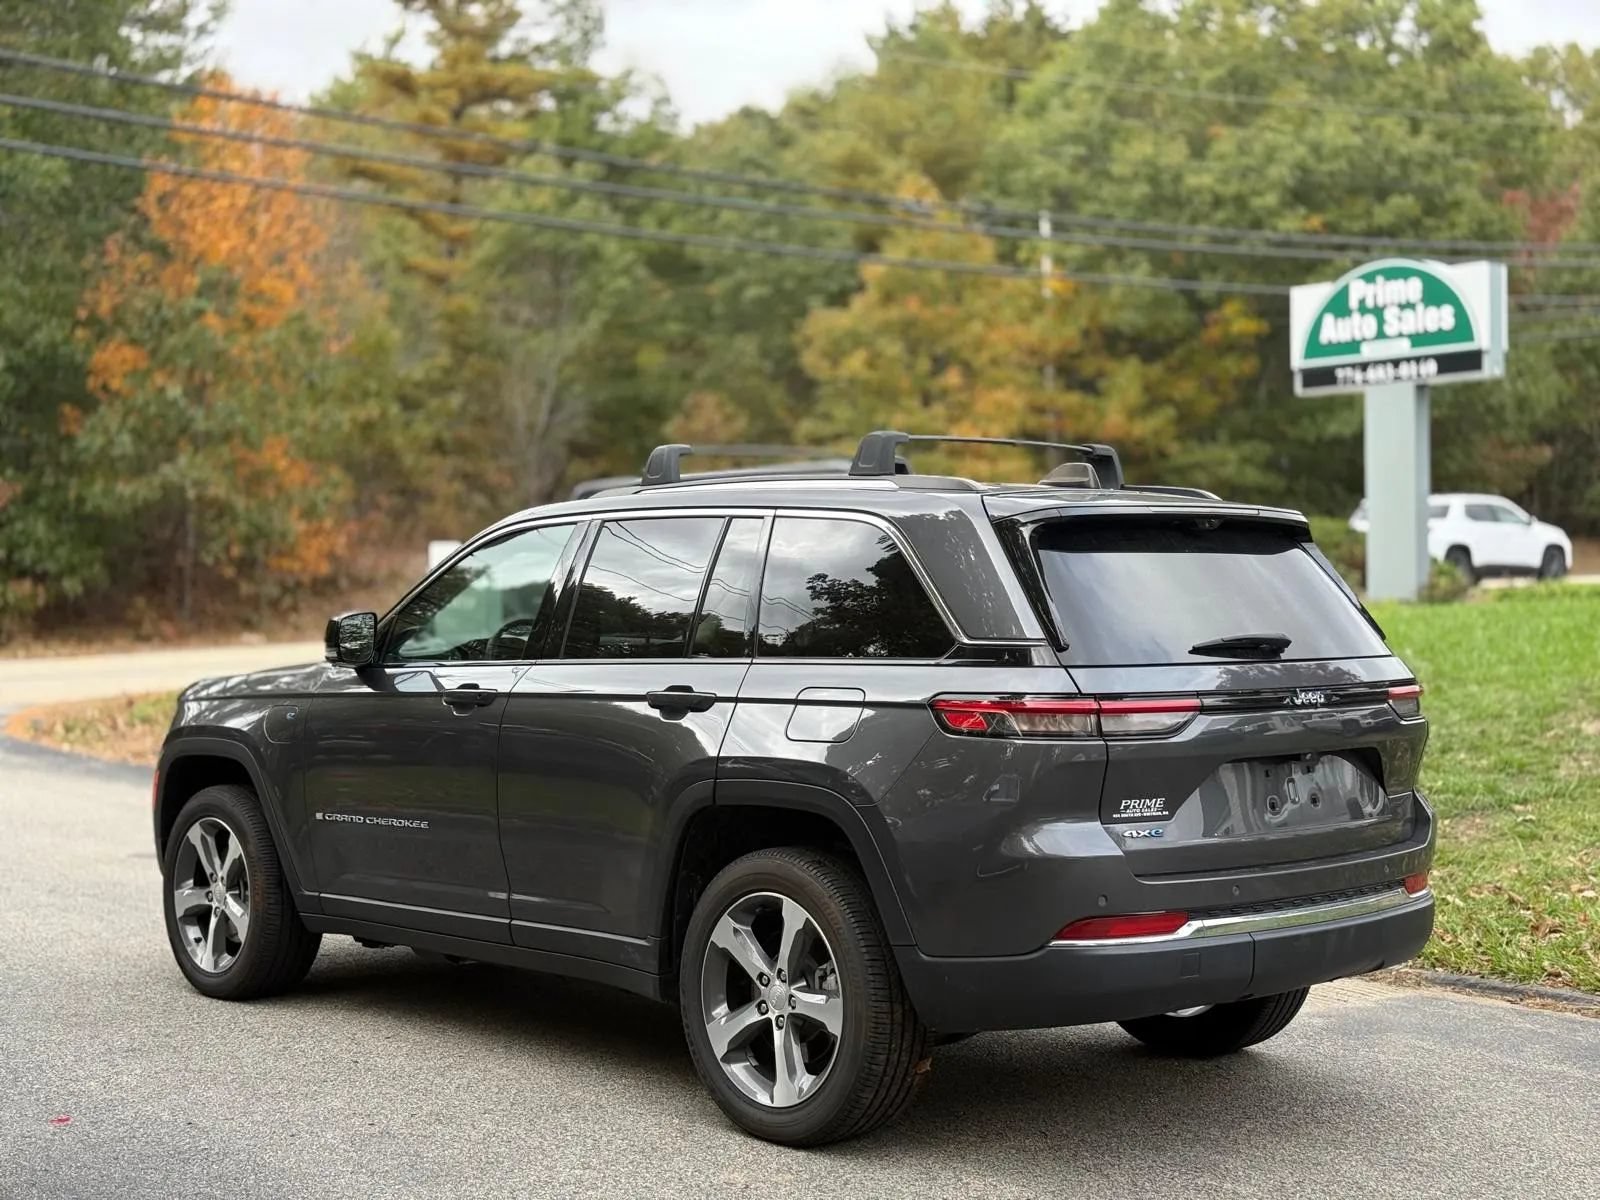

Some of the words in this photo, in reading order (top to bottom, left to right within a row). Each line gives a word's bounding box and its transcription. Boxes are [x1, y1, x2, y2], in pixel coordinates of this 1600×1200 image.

[1349, 274, 1423, 310] Prime
[1319, 312, 1378, 345] Auto
[1383, 301, 1456, 337] Sales
[1293, 688, 1325, 707] Jeep
[1120, 798, 1165, 810] PRIME
[324, 813, 364, 823] GRAND
[365, 817, 430, 829] CHEROKEE
